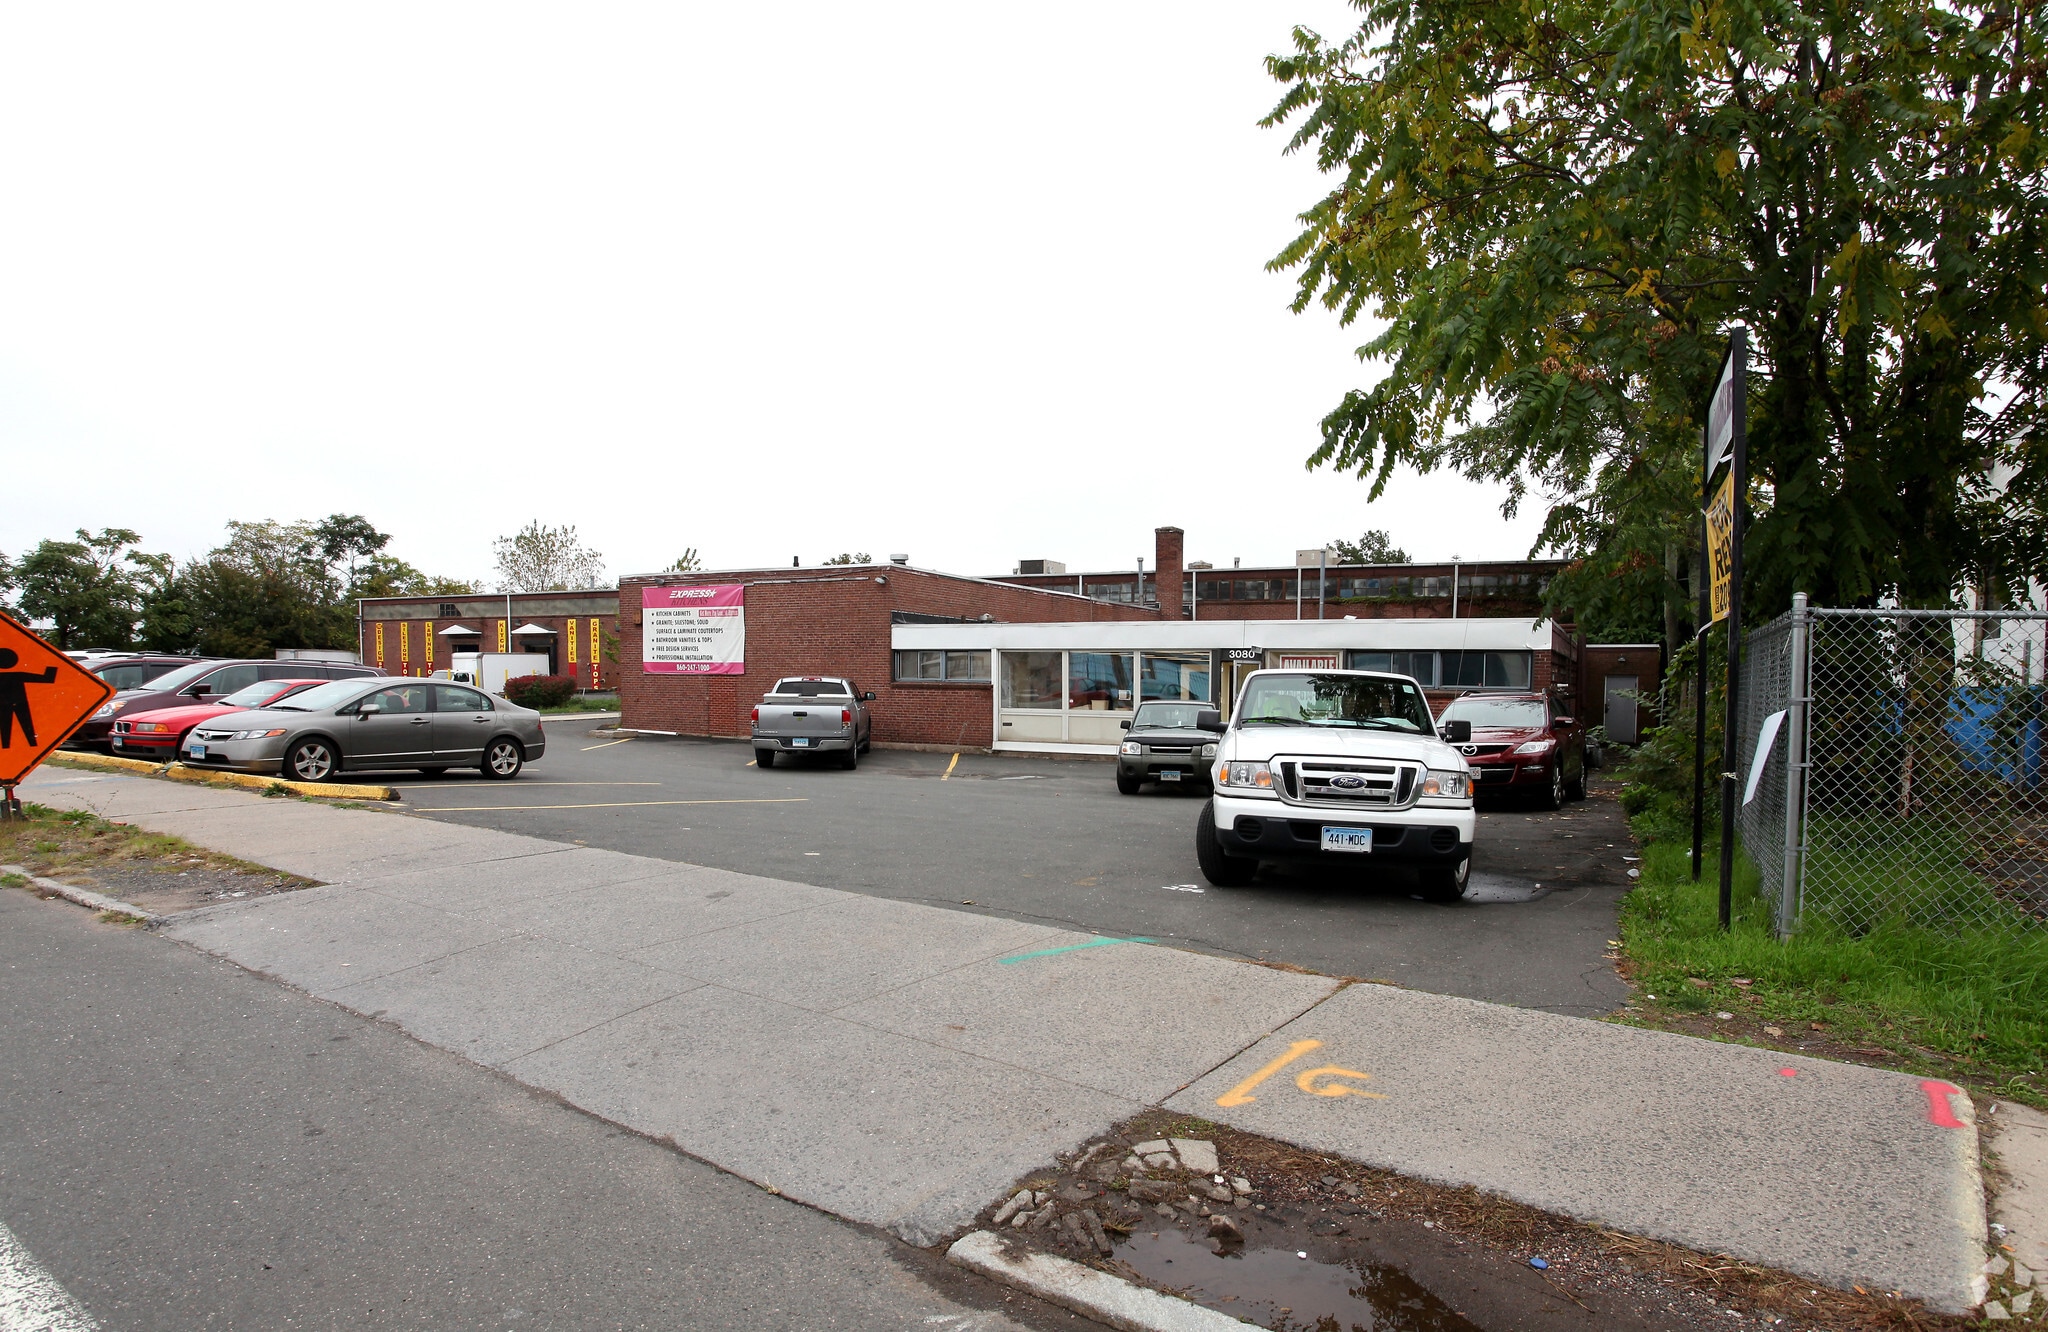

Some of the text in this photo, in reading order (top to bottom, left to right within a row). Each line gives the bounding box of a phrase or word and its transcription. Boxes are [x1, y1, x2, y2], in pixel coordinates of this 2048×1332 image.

[669, 589, 711, 599] EXPRESS
[671, 598, 708, 606] KITCHENS
[1229, 650, 1255, 659] 3080
[1338, 777, 1359, 787] Ford
